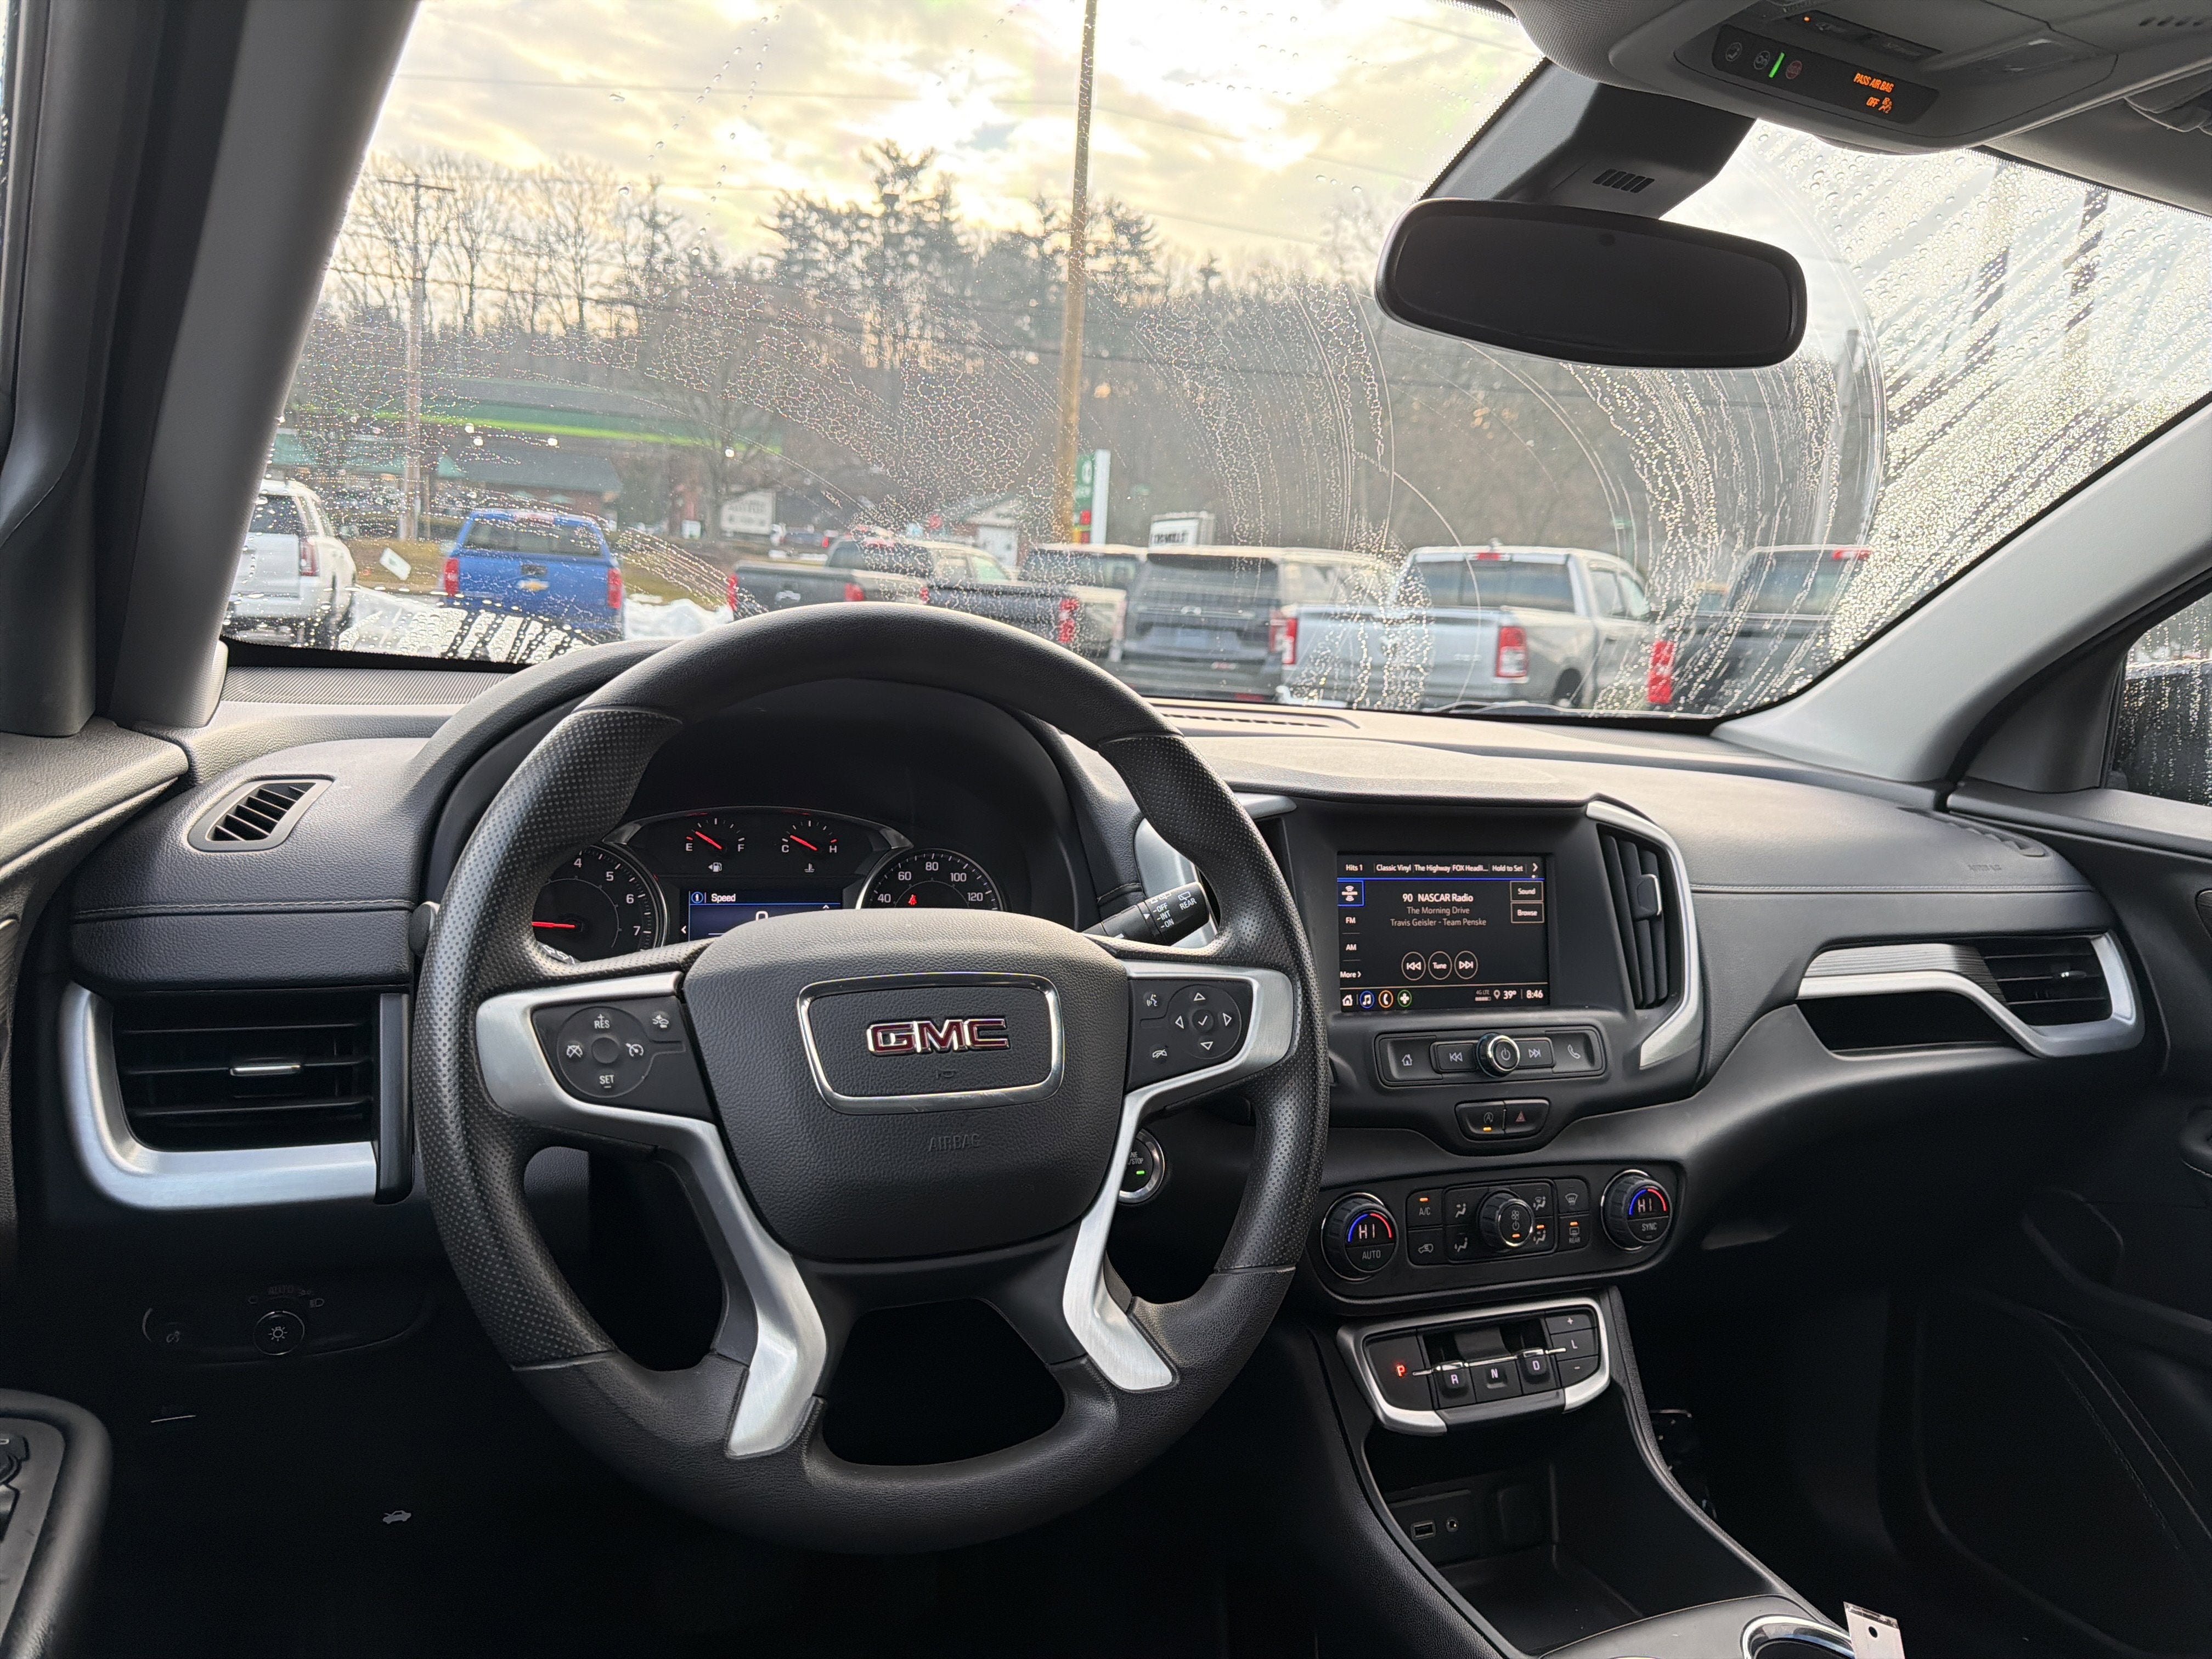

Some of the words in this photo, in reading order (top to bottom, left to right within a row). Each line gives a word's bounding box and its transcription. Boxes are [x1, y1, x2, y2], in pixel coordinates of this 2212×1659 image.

[1853, 72, 1871, 86] PASS
[1869, 78, 1882, 89] AIR
[1879, 81, 1894, 93] BAG
[1866, 97, 1880, 108] OFF
[781, 844, 789, 853] C
[573, 858, 582, 868] 4
[926, 861, 939, 871] 80
[1397, 864, 1412, 873] Vinyl
[1426, 865, 1451, 873] Highway
[606, 871, 614, 881] 5
[898, 872, 912, 881] 60
[950, 872, 967, 882] 100
[626, 894, 634, 904] 6
[711, 893, 736, 903] Speed
[878, 894, 891, 903] 40
[967, 893, 983, 901] 120
[1402, 894, 1413, 902] 90
[1418, 893, 1451, 902] NASCAR
[1452, 893, 1474, 902] Radio
[1156, 902, 1168, 913] OFF
[1179, 898, 1197, 911] REAR
[1159, 910, 1171, 921] INT
[1406, 906, 1420, 915] The
[1421, 906, 1451, 916] Morning
[1452, 906, 1470, 914] Drive
[1164, 918, 1175, 928] ON
[1390, 918, 1410, 927] Travis
[1412, 918, 1436, 927] Geisler
[1463, 918, 1487, 926] Penske
[633, 926, 641, 936] 7
[1526, 990, 1544, 999] 8:46
[594, 1020, 610, 1029] RES
[866, 1018, 1011, 1056] GMC
[599, 1075, 614, 1085] SET
[928, 1133, 980, 1153] AIRBAG
[1638, 1198, 1652, 1213] HI
[1419, 1207, 1431, 1216] A/C
[1359, 1223, 1375, 1239] HI
[1642, 1222, 1657, 1232] SYNC
[1362, 1250, 1381, 1260] AUTO
[1571, 1340, 1578, 1350] L
[1533, 1360, 1540, 1370] D
[1396, 1364, 1406, 1378] P
[1491, 1368, 1499, 1379] N
[1451, 1374, 1459, 1385] R
